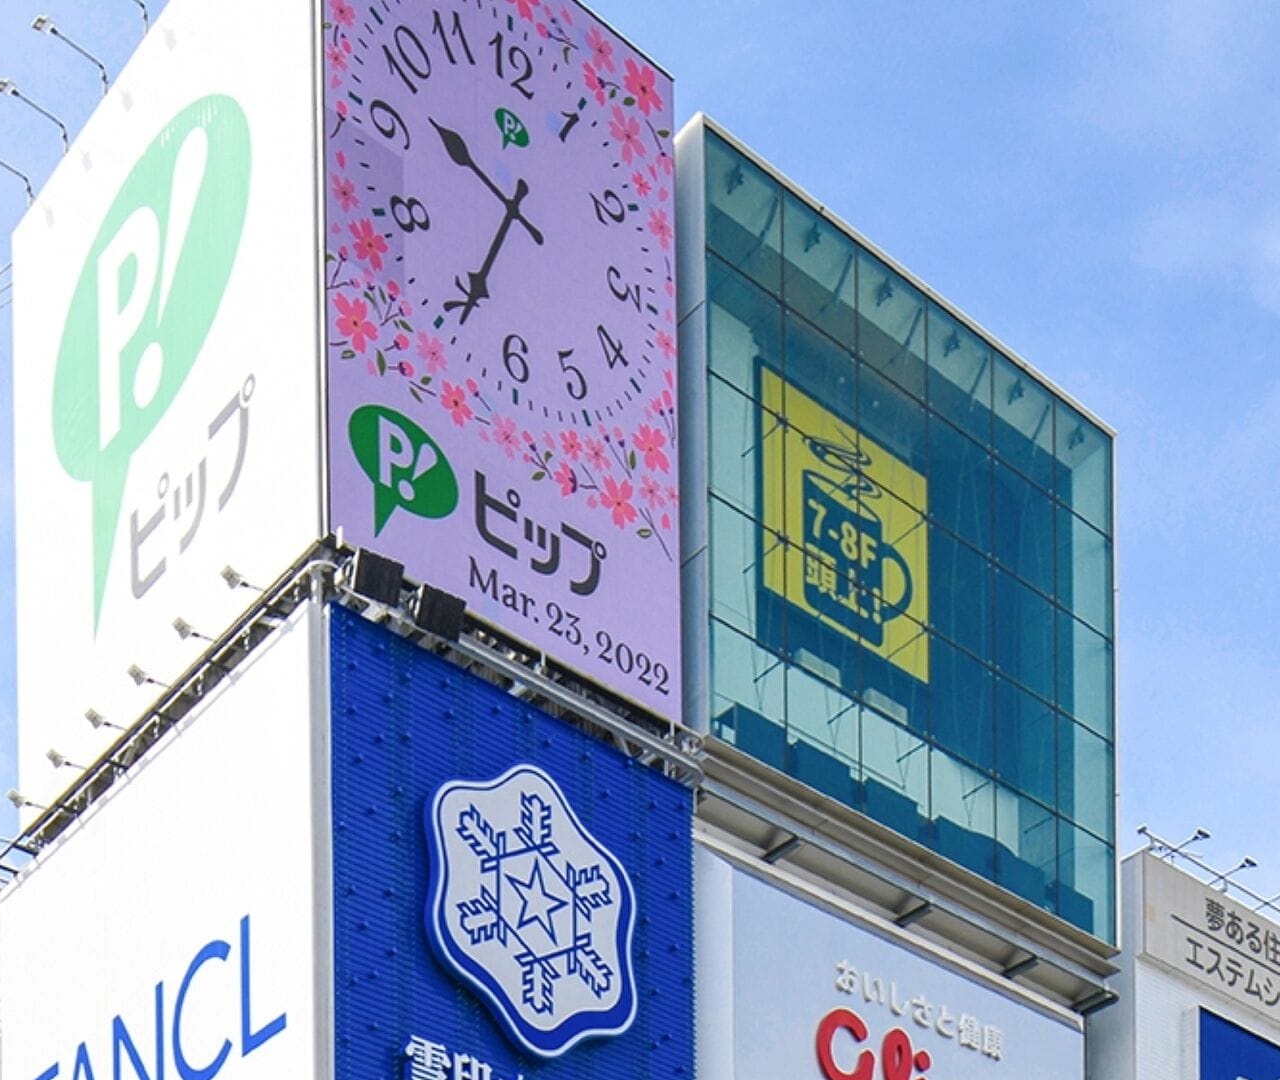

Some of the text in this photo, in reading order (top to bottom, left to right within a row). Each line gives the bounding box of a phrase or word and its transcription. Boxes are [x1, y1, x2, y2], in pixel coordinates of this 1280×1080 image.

[381, 25, 432, 94] 10
[432, 9, 476, 66] 11
[488, 32, 535, 100] 12
[369, 99, 410, 150] 9
[557, 110, 581, 143] 1
[389, 195, 431, 233] 8
[588, 189, 626, 227] 2
[606, 265, 643, 312] 3
[502, 333, 530, 383] 6
[596, 323, 629, 370] 4
[556, 348, 589, 400] 5
[129, 373, 256, 600] ピップ
[474, 469, 608, 596] ピップ
[468, 555, 539, 624] Mar.
[595, 630, 671, 696] 2022
[833, 959, 1004, 1062] おいしさと健康
